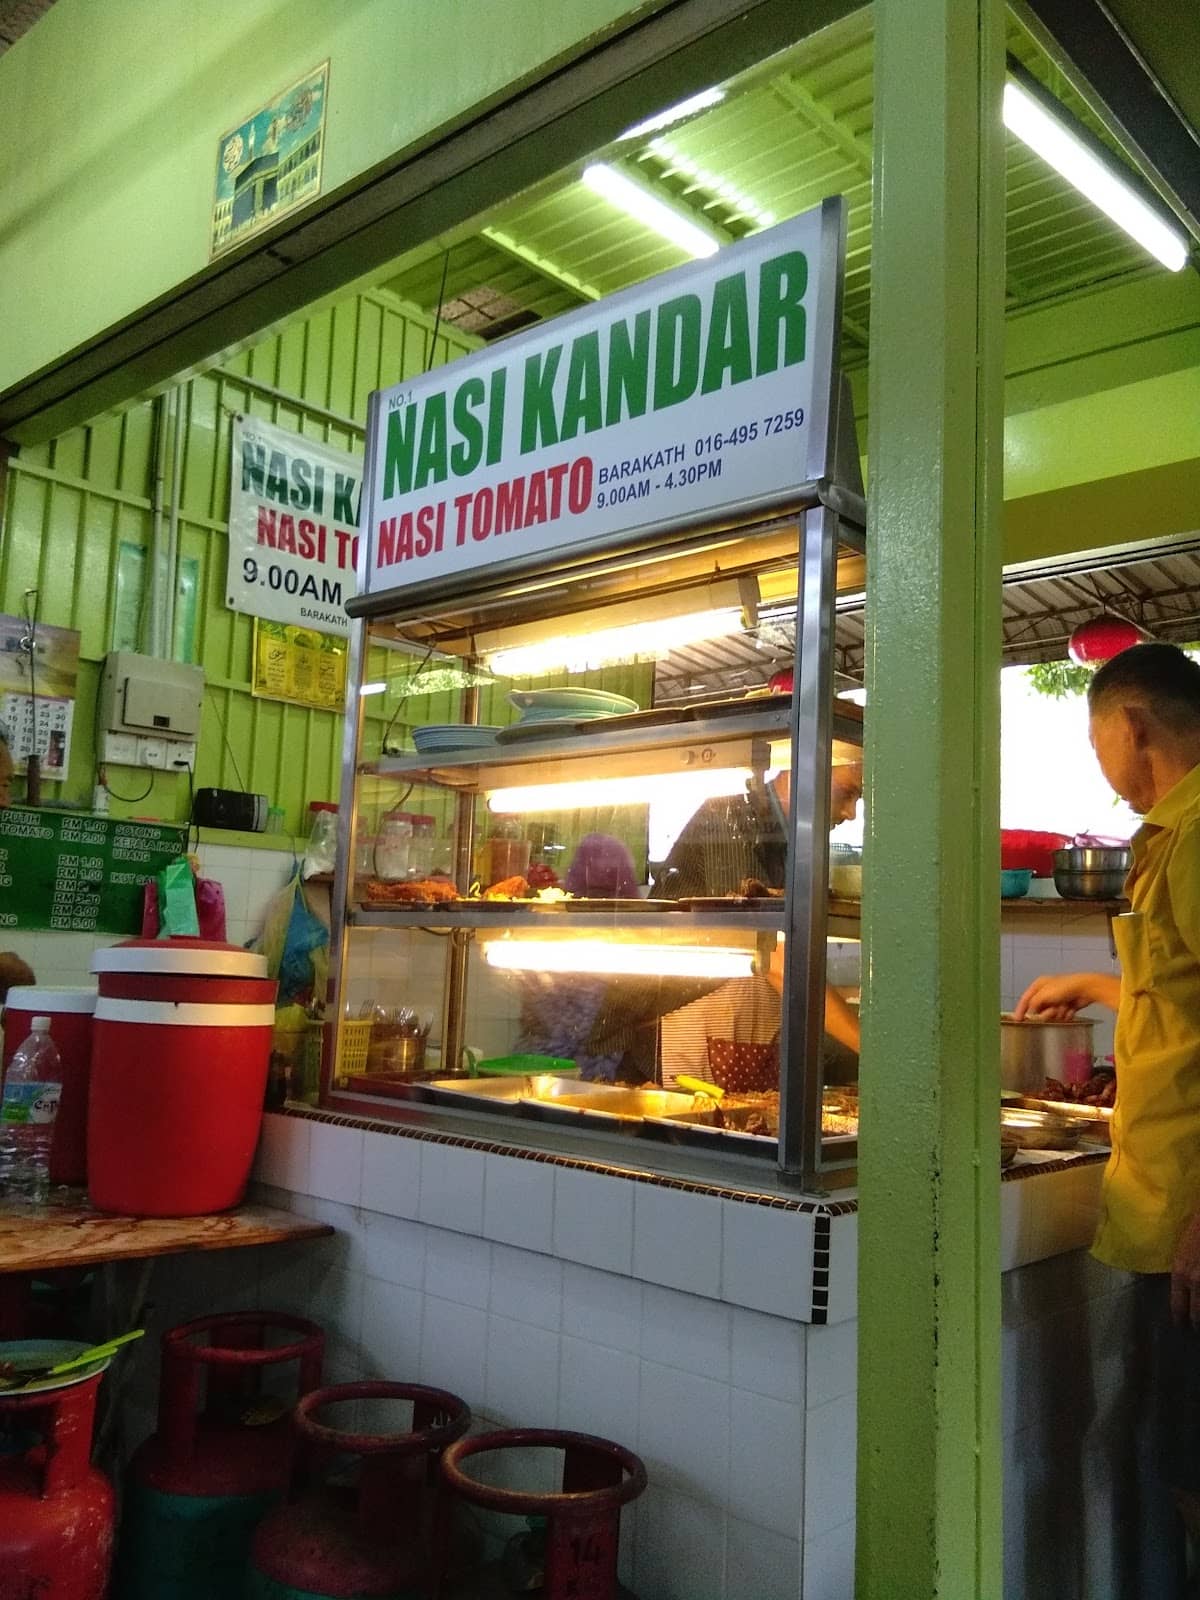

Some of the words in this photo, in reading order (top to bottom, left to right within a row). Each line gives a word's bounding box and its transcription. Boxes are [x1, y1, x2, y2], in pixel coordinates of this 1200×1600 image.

[383, 366, 507, 500] NASI
[520, 250, 808, 455] KANDAR
[388, 391, 413, 408] NO.1
[599, 443, 685, 485] BARAKATH
[695, 422, 758, 456] 016-495
[764, 408, 804, 436] 7259
[242, 440, 325, 515] NASI
[333, 472, 362, 527] K
[597, 480, 650, 509] 9.00AM
[665, 459, 722, 490] 4.30PM
[377, 501, 446, 568] NASI
[454, 456, 593, 547] TOMATO
[257, 505, 326, 564] NASI
[242, 558, 342, 606] 9.00AM
[300, 607, 348, 627] BARAKATH
[2, 810, 40, 825] PUTIH
[62, 818, 81, 830] RM
[83, 820, 108, 833] 1.00
[0, 823, 54, 839] TOMATO
[61, 830, 80, 842] RM
[58, 854, 79, 867] RM
[80, 856, 104, 869] 1.00
[57, 867, 78, 879] RM
[80, 869, 103, 881] 1.00
[56, 880, 77, 892] RM
[54, 892, 75, 904] RM
[52, 904, 72, 916] RM
[51, 916, 71, 928] RM
